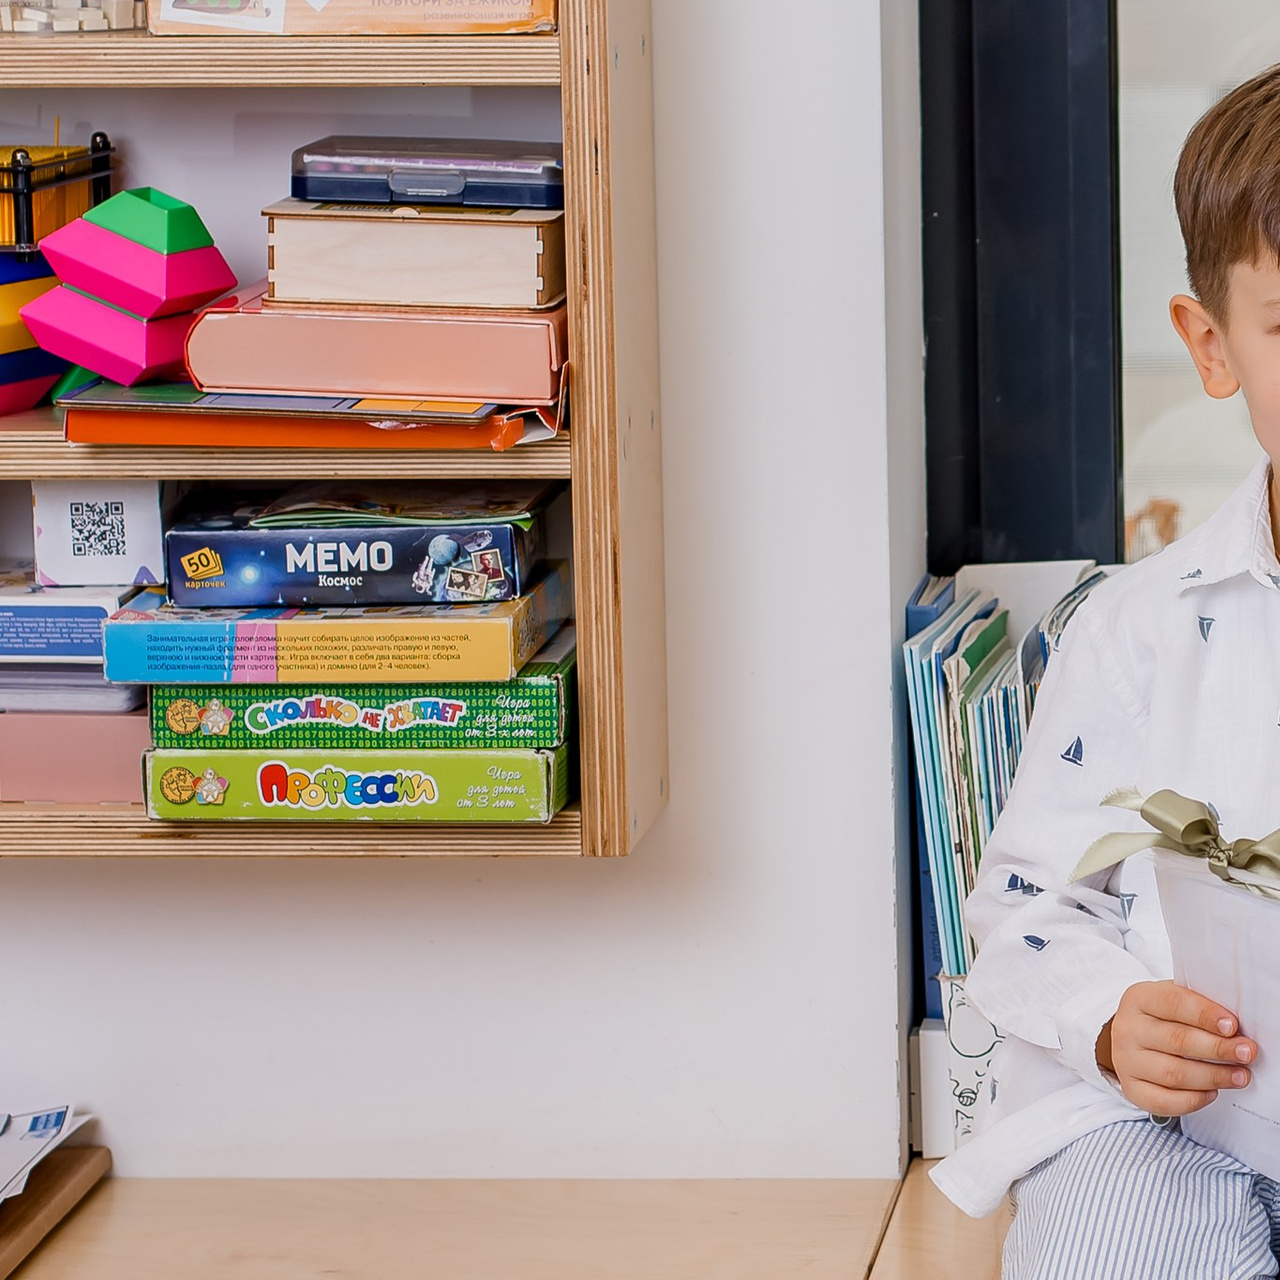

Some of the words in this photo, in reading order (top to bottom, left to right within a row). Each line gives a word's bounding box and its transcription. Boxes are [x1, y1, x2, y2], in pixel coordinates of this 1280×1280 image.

[423, 11, 504, 21] развивающая
[507, 10, 534, 21] игра
[186, 551, 210, 573] 50
[185, 579, 226, 590] карточек
[318, 574, 363, 587] Космос
[146, 635, 209, 644] Занимательная
[283, 634, 310, 644] научит
[312, 634, 349, 644] собирать
[350, 635, 374, 644] целое
[376, 634, 429, 644] изображение
[147, 645, 183, 653] находить
[184, 644, 216, 653] нужный
[268, 644, 312, 652] нескольких
[351, 644, 392, 652] различать
[393, 644, 424, 653] правую
[147, 655, 183, 663] верхнюю
[290, 653, 309, 663] Игра
[310, 653, 347, 662] включает
[355, 653, 375, 662] себя
[375, 654, 390, 662] два
[432, 653, 461, 662] сборка
[327, 663, 357, 671] домино
[359, 662, 376, 671] (для
[496, 694, 532, 709] Игра
[248, 698, 358, 729] СКОЛЬКО
[362, 711, 382, 729] НЕ
[387, 700, 463, 729] ХВАТАЕТ
[487, 766, 522, 782] Игра
[259, 763, 436, 807] ПРОФЕССИИ
[467, 785, 489, 798] для
[492, 784, 526, 797] детей
[456, 798, 473, 808] от
[477, 795, 489, 808] 3
[492, 798, 515, 808] лет
